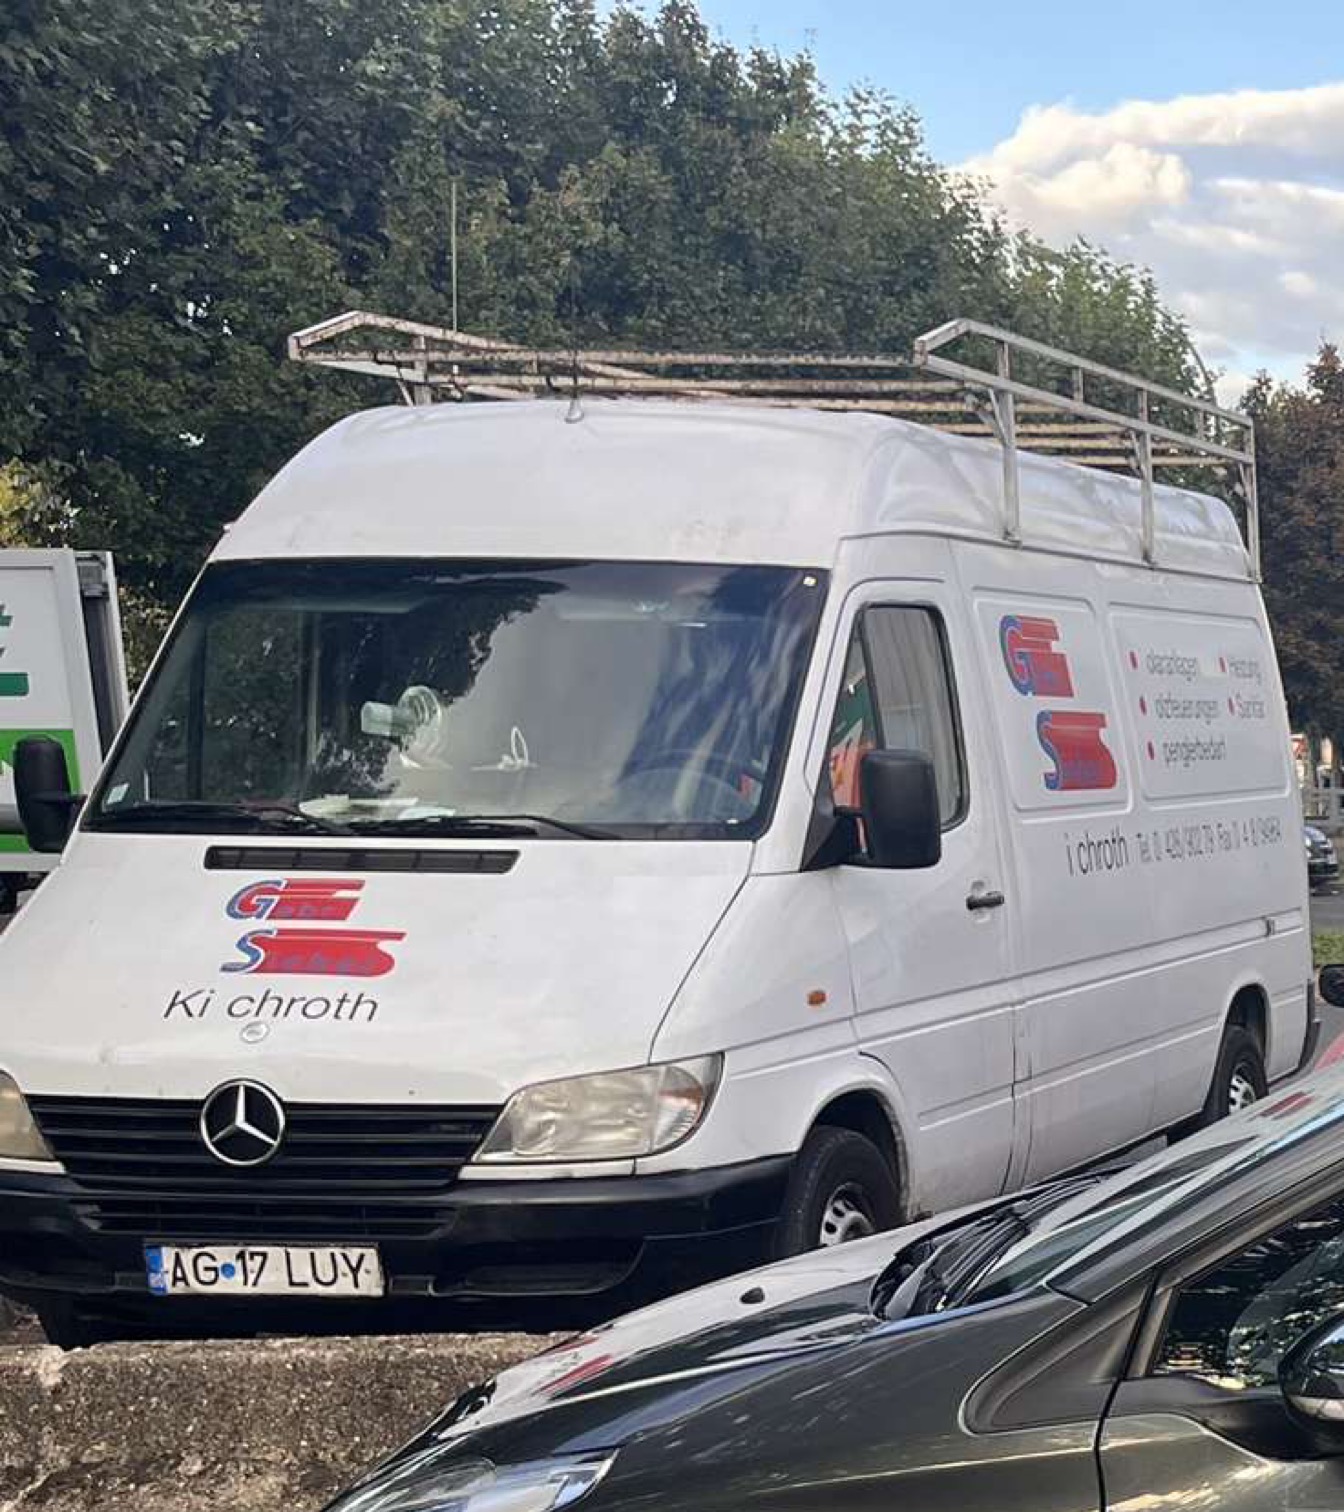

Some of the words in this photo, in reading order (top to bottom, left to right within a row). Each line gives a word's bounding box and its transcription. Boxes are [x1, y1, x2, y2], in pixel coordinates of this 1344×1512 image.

[163, 988, 216, 1019] Ki
[227, 987, 379, 1022] chroth
[171, 1251, 220, 1288] AG
[235, 1250, 268, 1287] 17
[284, 1249, 366, 1289] LUY
